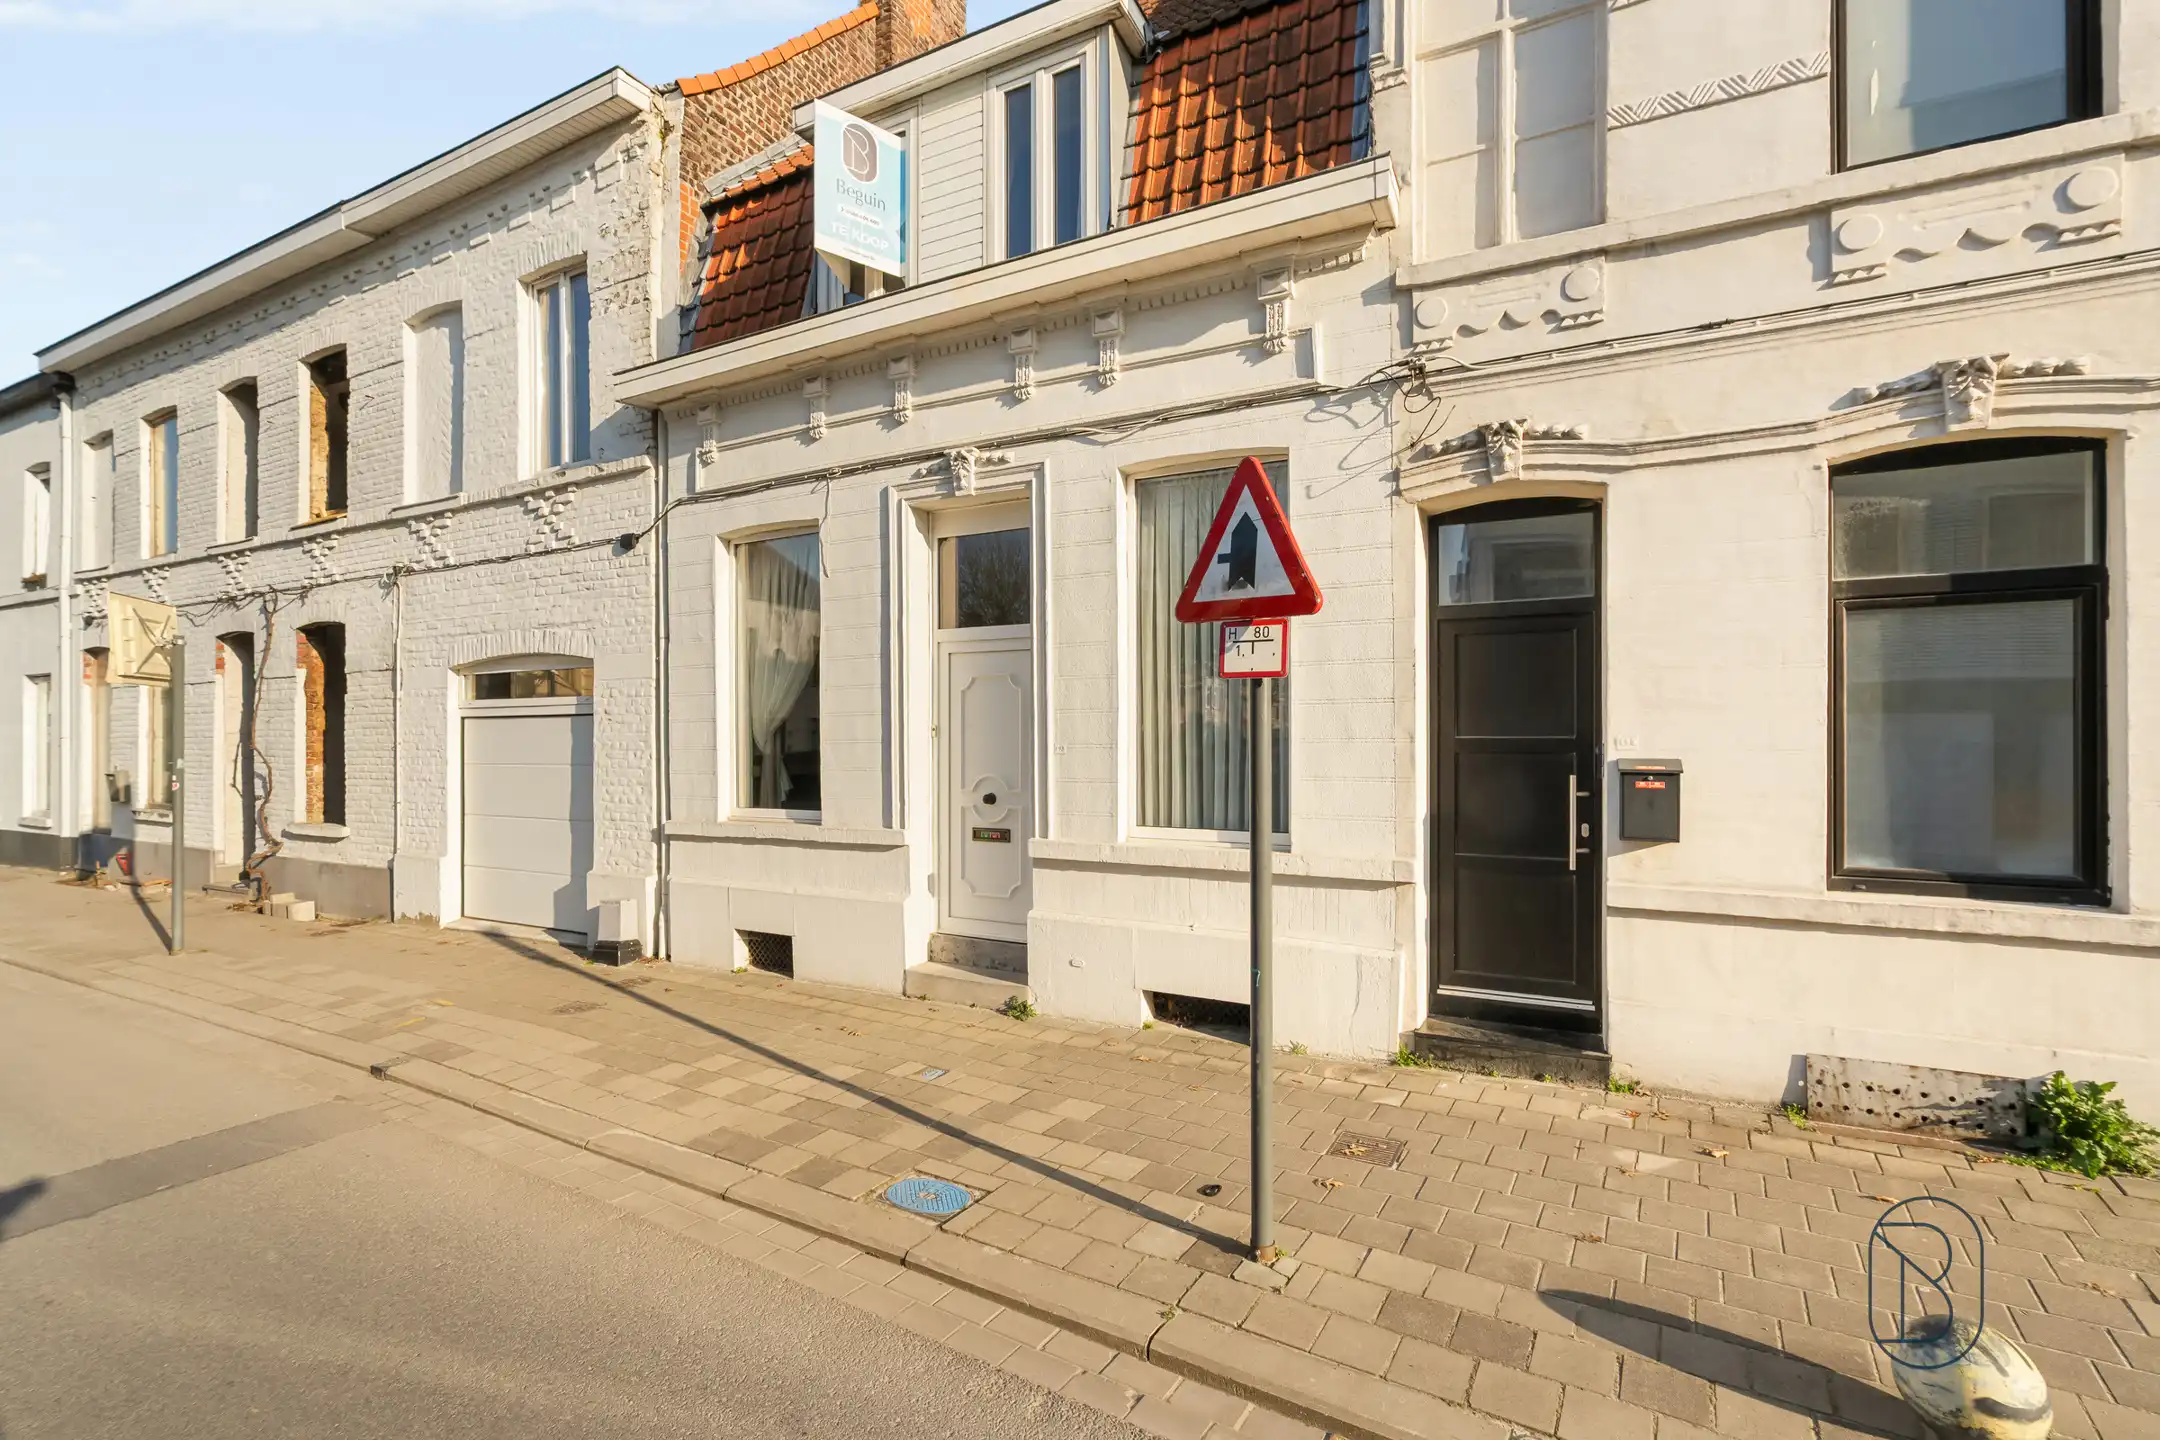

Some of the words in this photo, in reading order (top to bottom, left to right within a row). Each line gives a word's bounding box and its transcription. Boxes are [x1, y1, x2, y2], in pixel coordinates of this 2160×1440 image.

[836, 178, 886, 212] Beguin
[1228, 627, 1237, 640] H
[1253, 626, 1270, 639] 80
